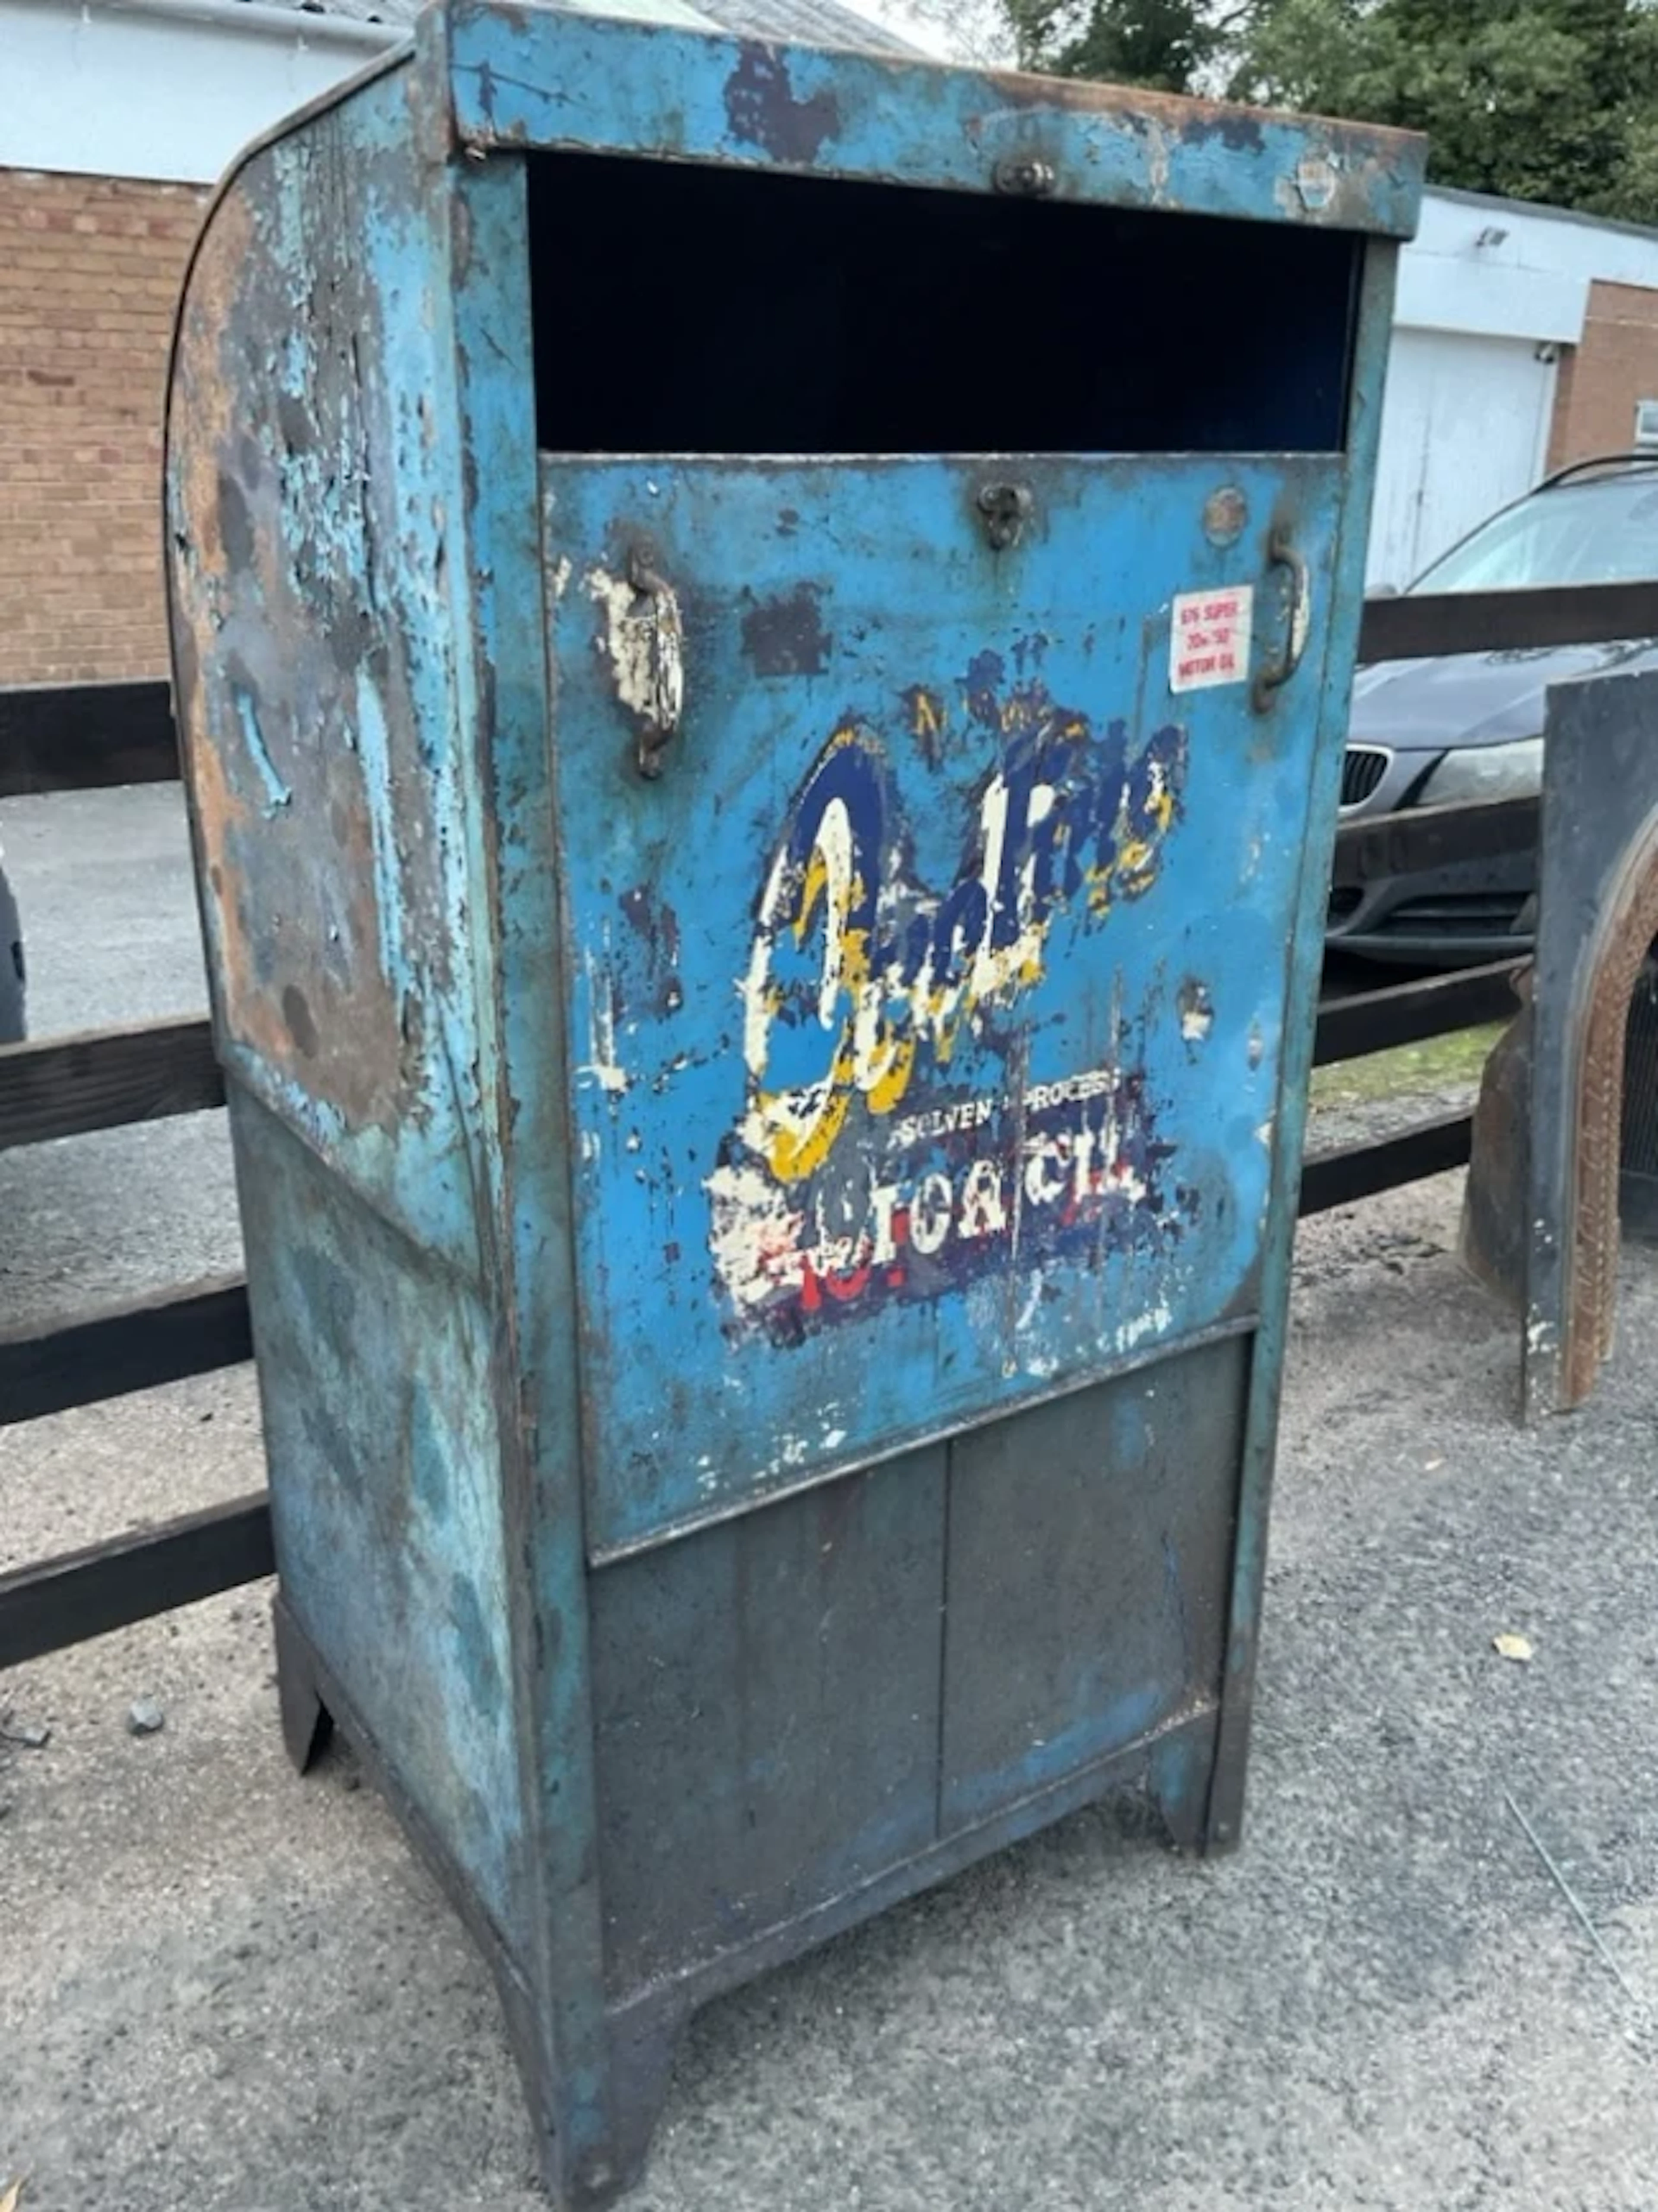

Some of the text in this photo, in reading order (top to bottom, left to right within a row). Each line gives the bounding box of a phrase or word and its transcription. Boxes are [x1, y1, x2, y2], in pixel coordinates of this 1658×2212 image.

[1179, 653, 1235, 677] MOTOR OIL
[889, 1095, 1009, 1150] SOLVEN
